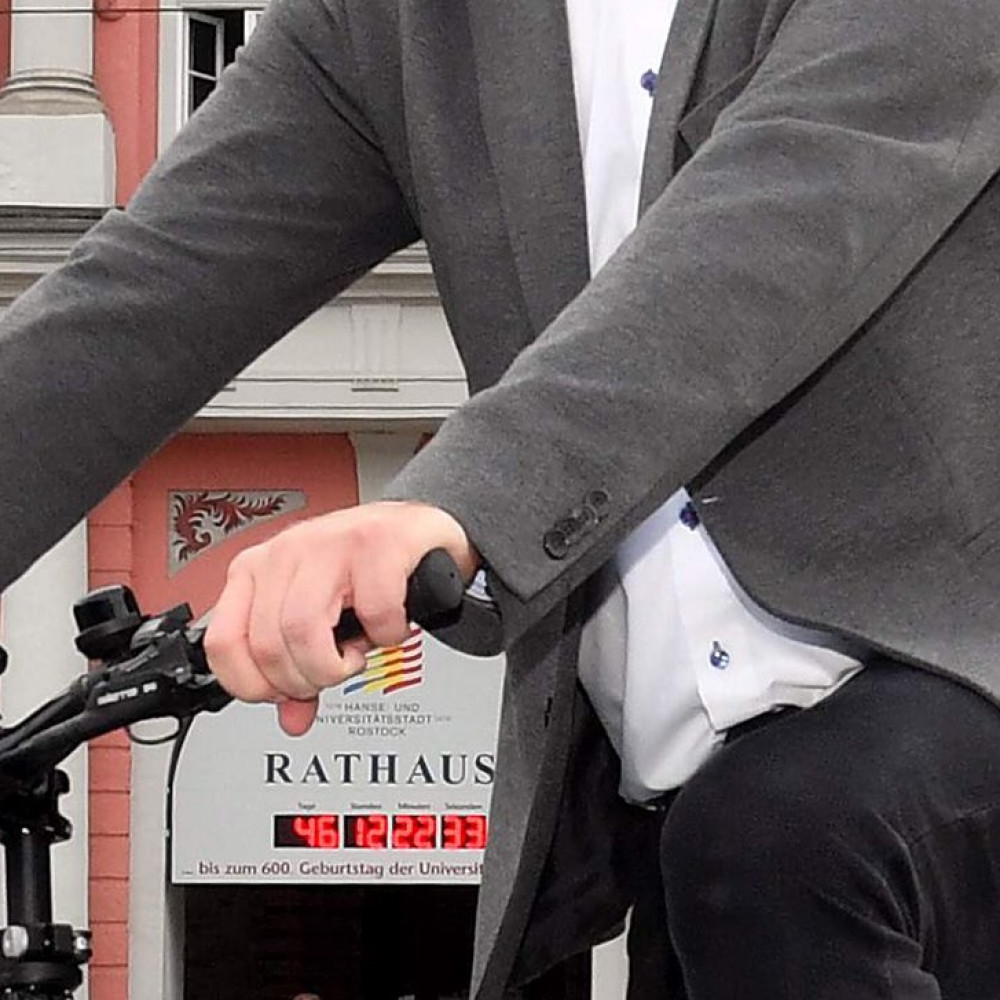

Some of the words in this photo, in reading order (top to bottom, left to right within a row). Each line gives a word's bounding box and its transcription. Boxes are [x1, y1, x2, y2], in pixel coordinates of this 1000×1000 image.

[395, 702, 420, 712] UND
[348, 726, 407, 736] ROSTOCK
[264, 753, 494, 784] RATHAUS
[293, 815, 339, 849] 46
[355, 815, 387, 849] 12
[393, 815, 435, 849] 22
[444, 815, 486, 849] 33
[199, 861, 219, 875] bis
[226, 865, 257, 875] zum
[299, 861, 384, 878] Geburtstag
[389, 861, 412, 875] der
